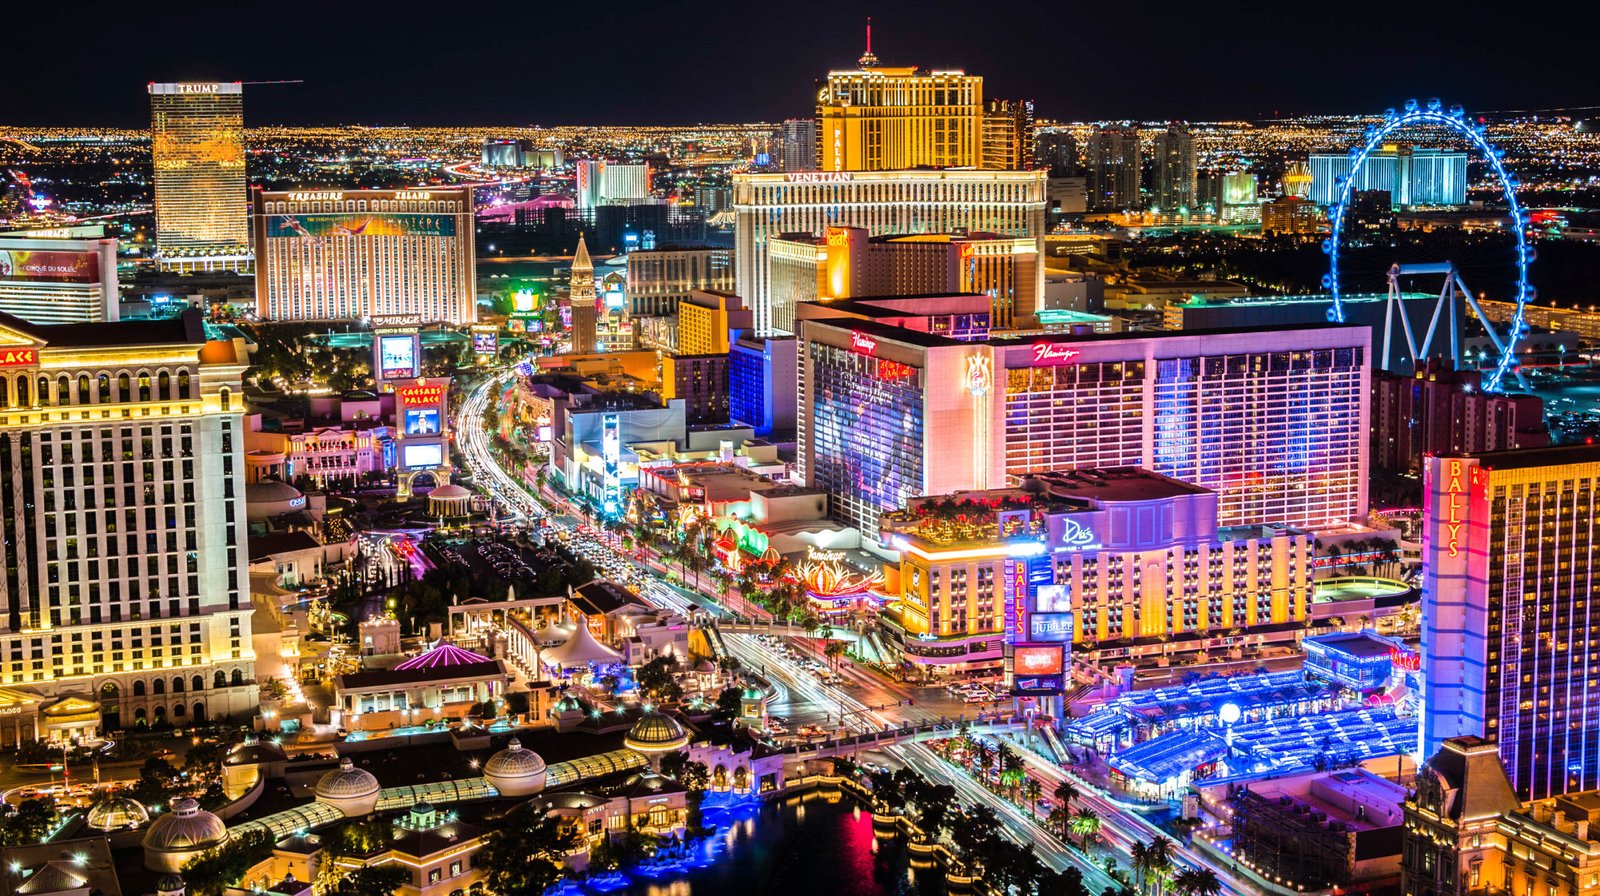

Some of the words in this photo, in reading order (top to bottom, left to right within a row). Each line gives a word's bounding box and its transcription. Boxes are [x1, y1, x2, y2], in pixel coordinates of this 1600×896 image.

[178, 84, 218, 93] TRUMP
[787, 172, 851, 182] VENETIAN
[288, 191, 343, 200] TREASURE
[395, 191, 430, 200] ISLAND
[25, 265, 47, 273] CIRQUE
[48, 265, 57, 273] DU
[57, 265, 77, 273] SOLEIL
[382, 316, 420, 325] MIRAGE
[852, 331, 876, 354] Flamingo
[1033, 344, 1080, 361] Flamingo
[402, 387, 440, 396] CAESARS
[404, 395, 439, 404] PALACE
[1448, 461, 1462, 557] BALLYS
[1015, 562, 1026, 635] BALLYS
[1032, 621, 1073, 635] JUBILEE
